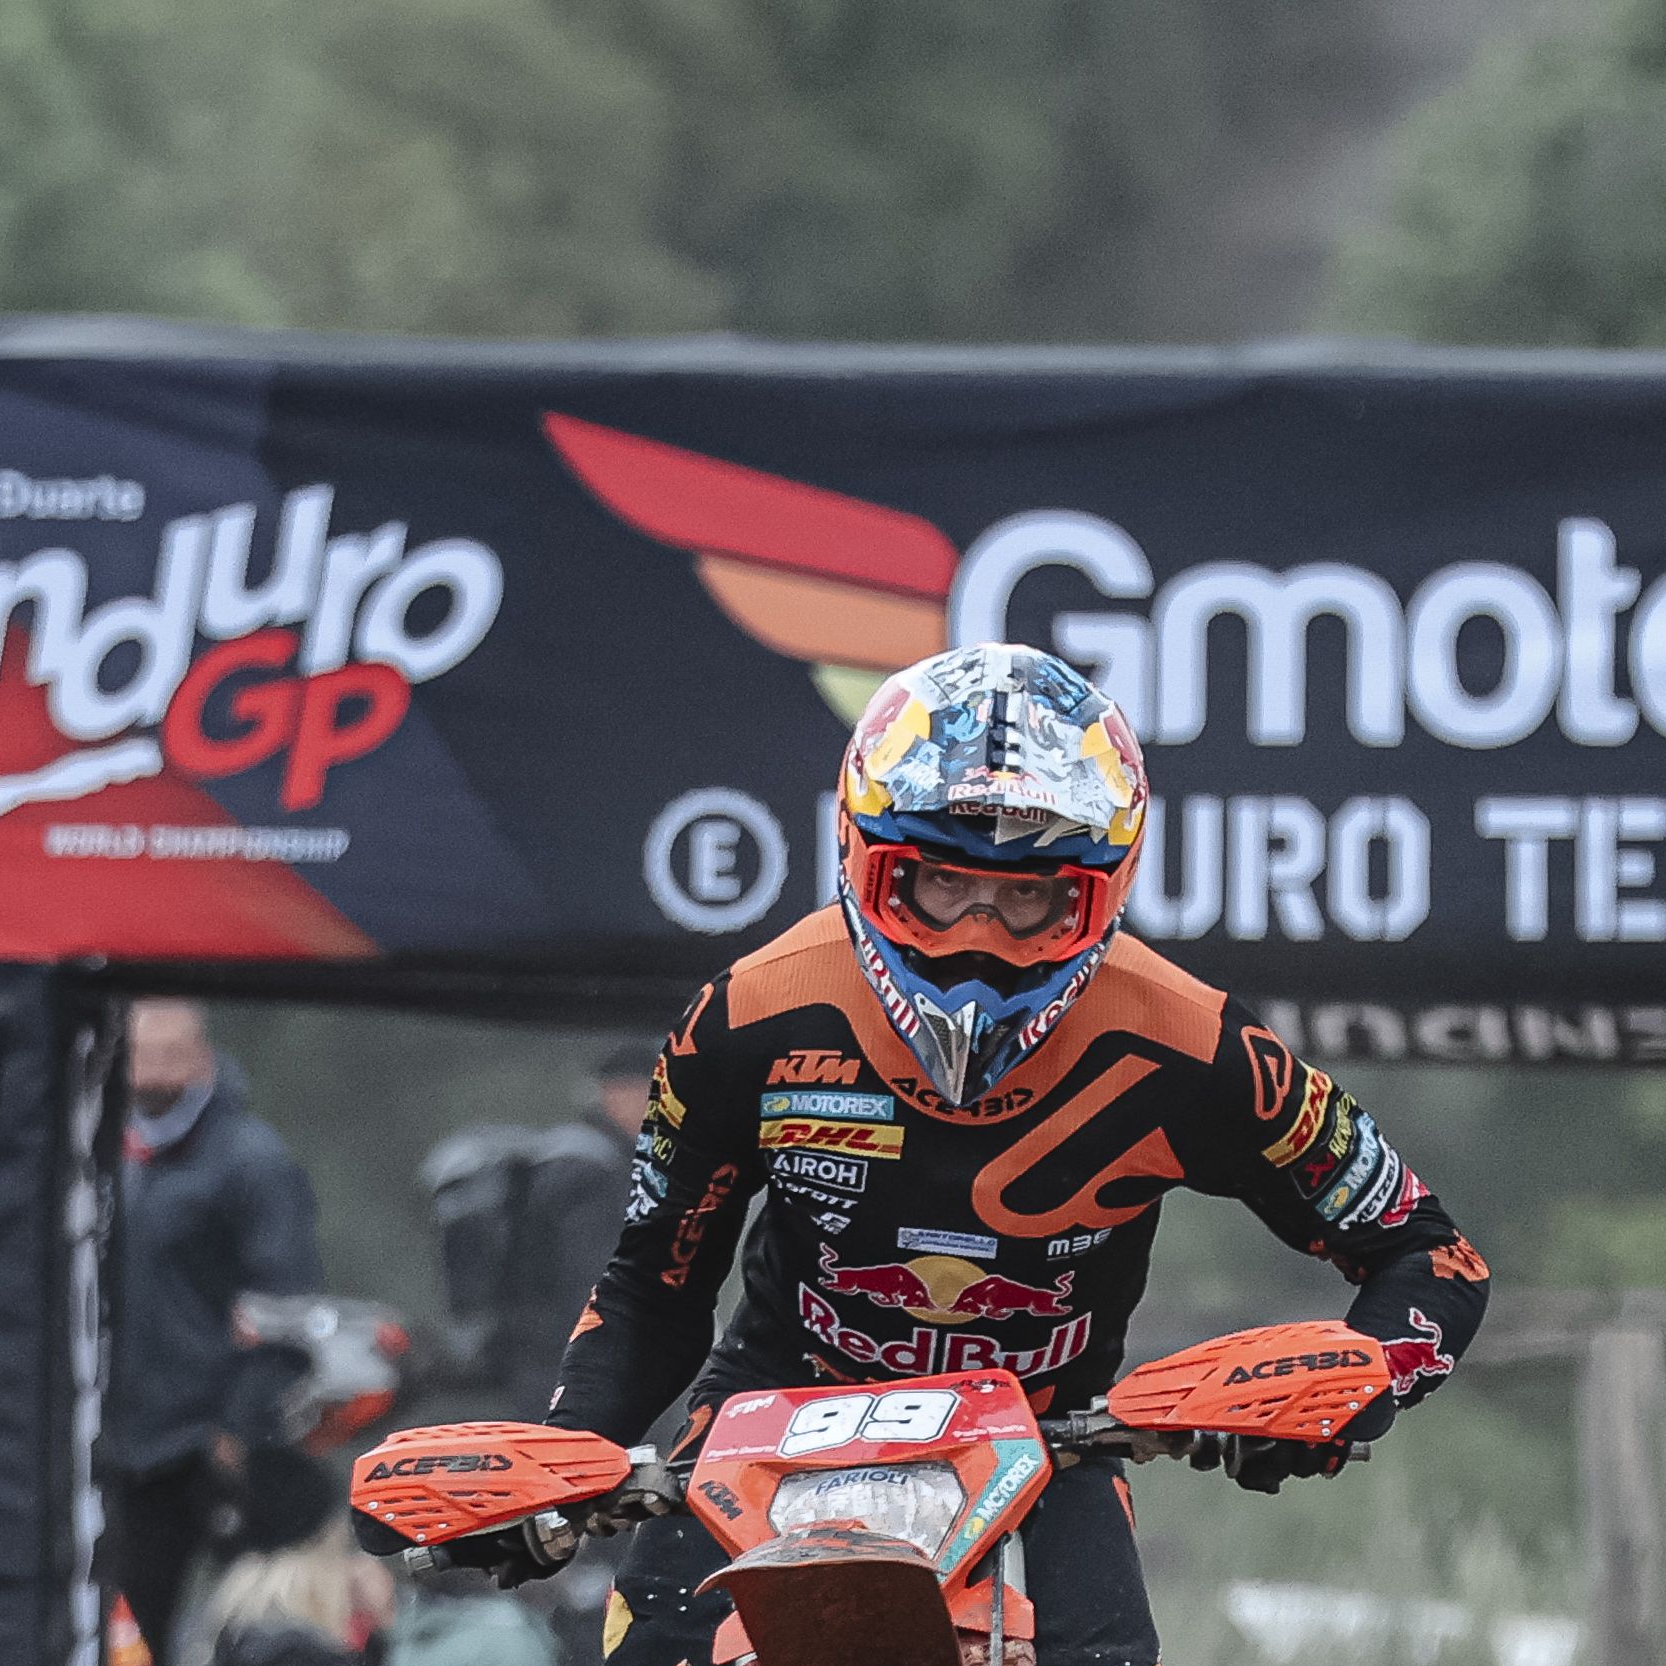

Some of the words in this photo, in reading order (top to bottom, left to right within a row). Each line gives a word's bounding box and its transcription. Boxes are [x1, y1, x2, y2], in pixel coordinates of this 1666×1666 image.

[766, 1049, 861, 1085] KTM
[790, 1093, 888, 1116] MOTOREX
[777, 1123, 879, 1151] DHL
[773, 1152, 859, 1186] AIROH
[799, 1281, 938, 1375] Red
[941, 1311, 1093, 1380] Bull
[1222, 1349, 1374, 1387] ACERBIS
[777, 1389, 961, 1459] 99
[363, 1454, 514, 1483] ACERBIS
[815, 1470, 910, 1496] FARIOLI
[977, 1452, 1040, 1521] MOTOREX
[697, 1480, 743, 1522] KTM
